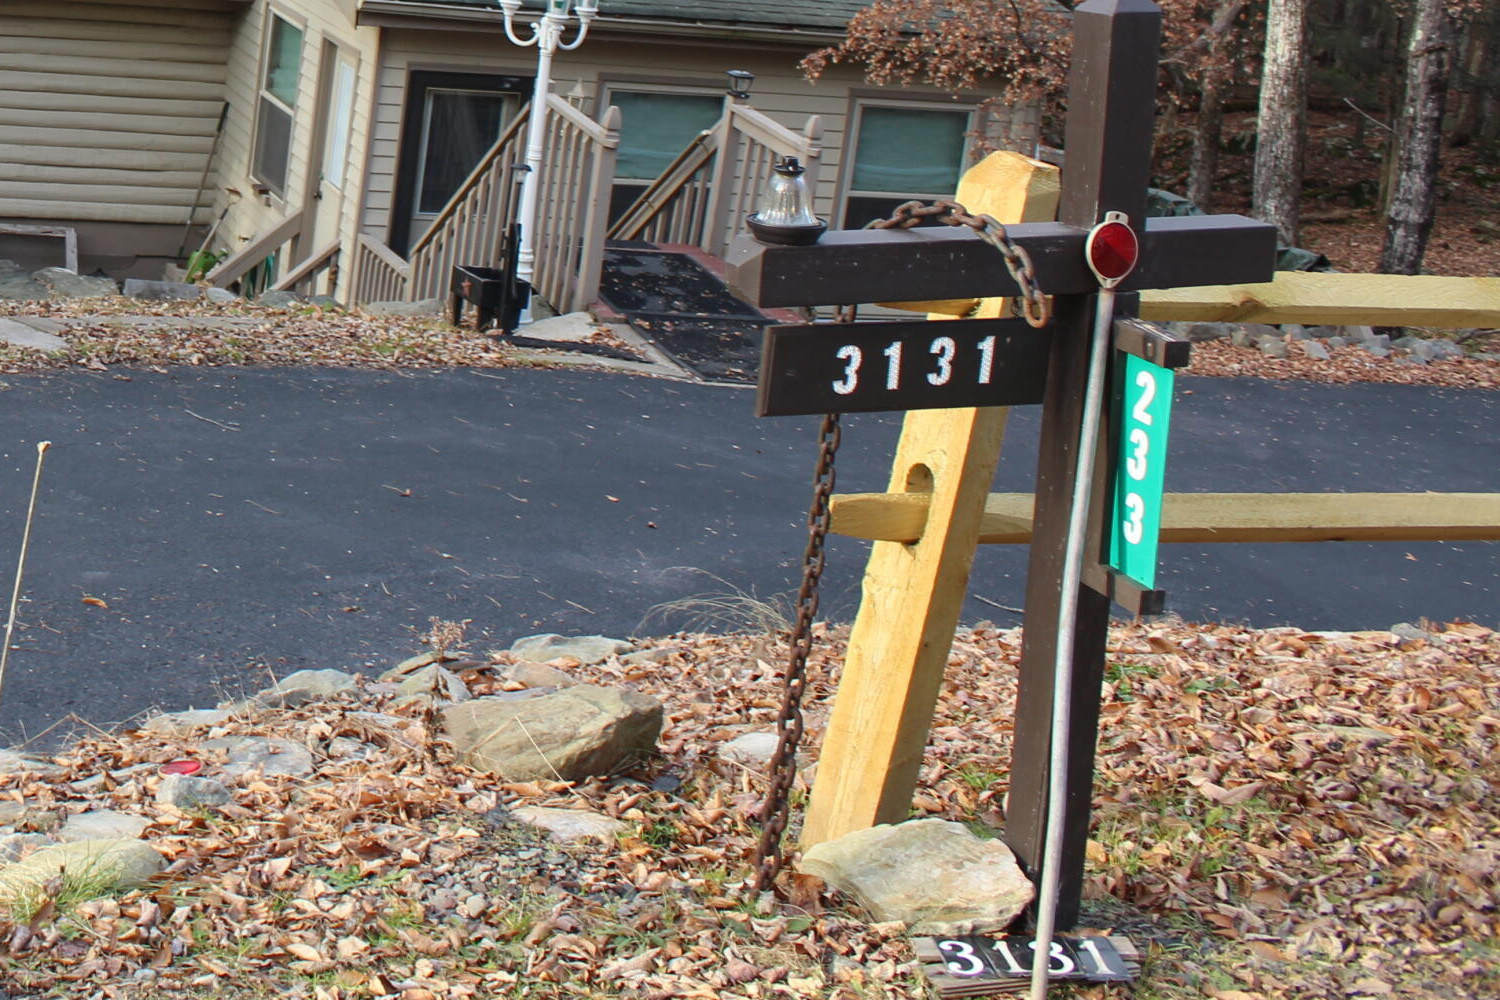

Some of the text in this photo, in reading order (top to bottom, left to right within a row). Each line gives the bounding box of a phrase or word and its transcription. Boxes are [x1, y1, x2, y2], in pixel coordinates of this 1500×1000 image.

[832, 335, 996, 396] 3131
[1122, 370, 1157, 545] 233
[938, 939, 1117, 976] 3131
